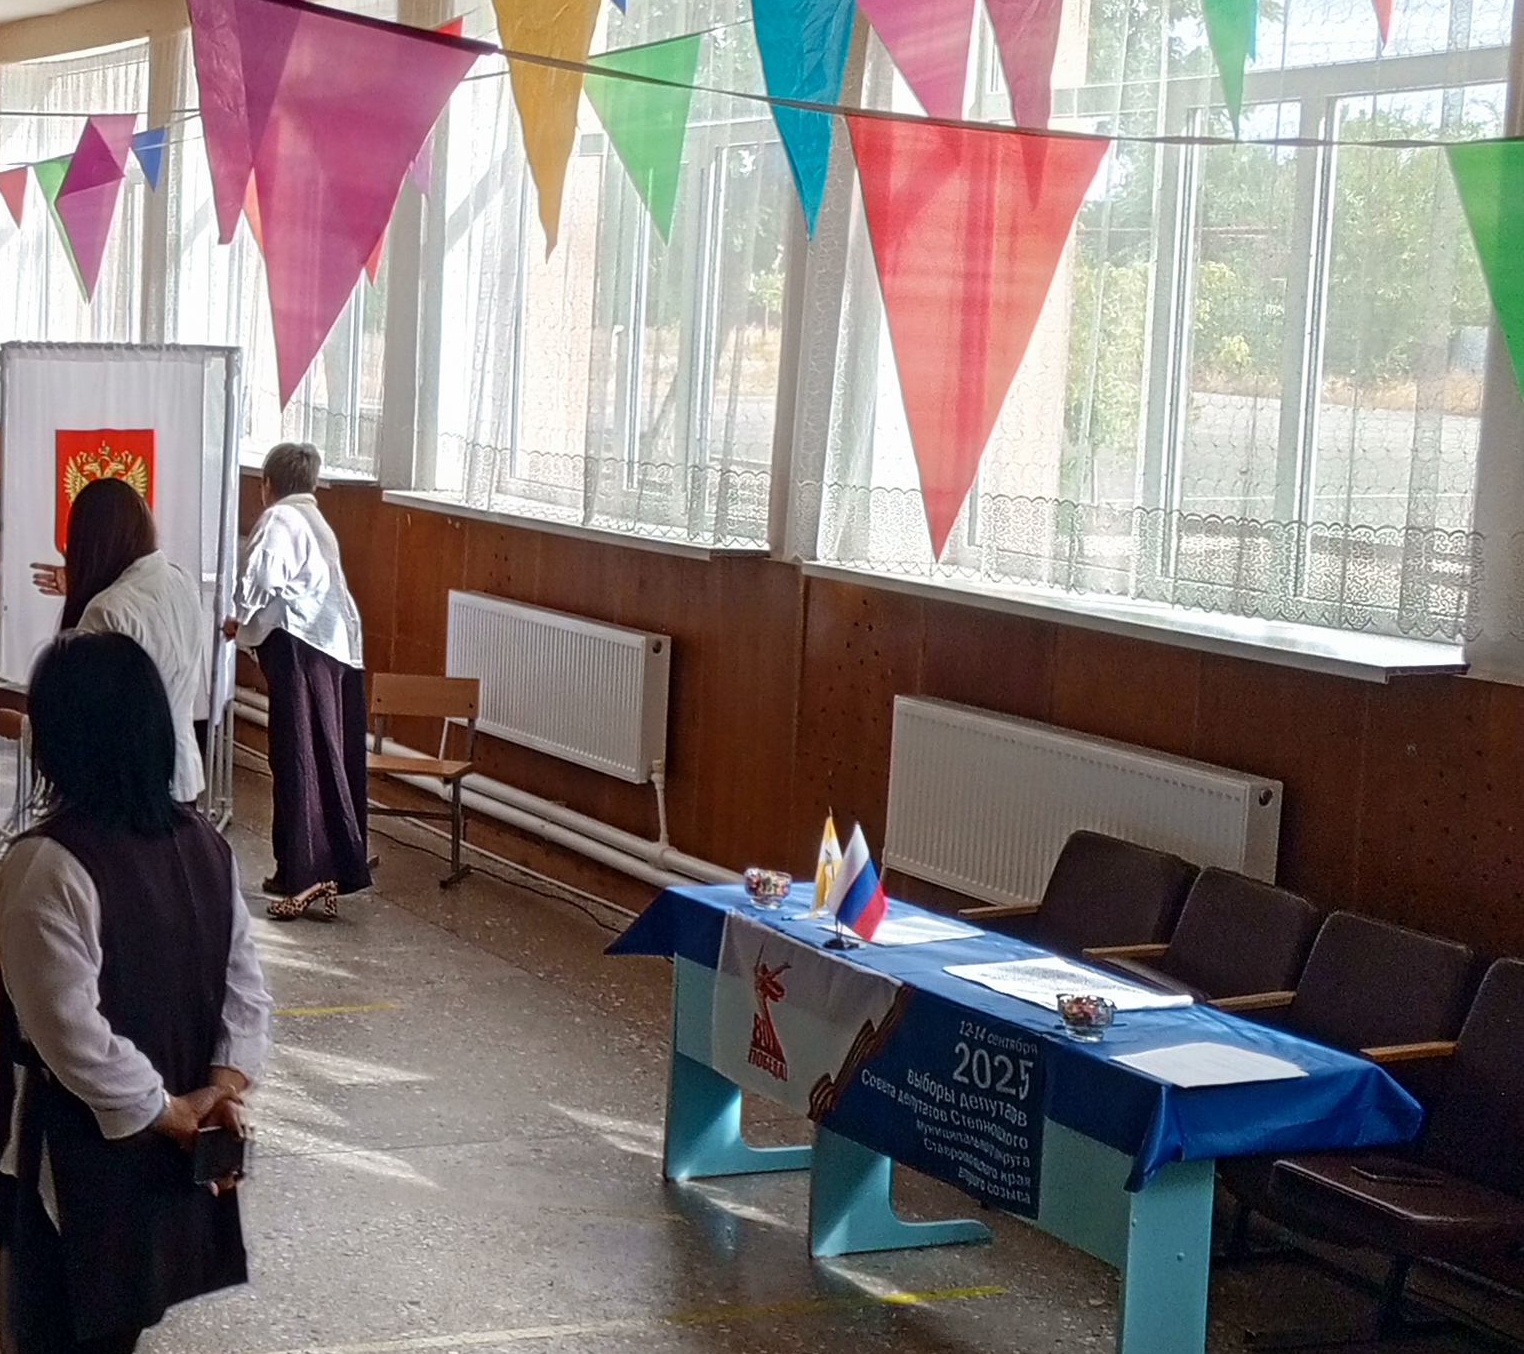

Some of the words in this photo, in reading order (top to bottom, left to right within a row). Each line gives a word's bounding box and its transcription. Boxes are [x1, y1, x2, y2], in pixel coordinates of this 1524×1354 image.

[959, 1020, 986, 1042] 12-14
[987, 1033, 1038, 1056] сентября
[907, 1068, 956, 1104] выборы
[952, 1042, 1033, 1101] 2025
